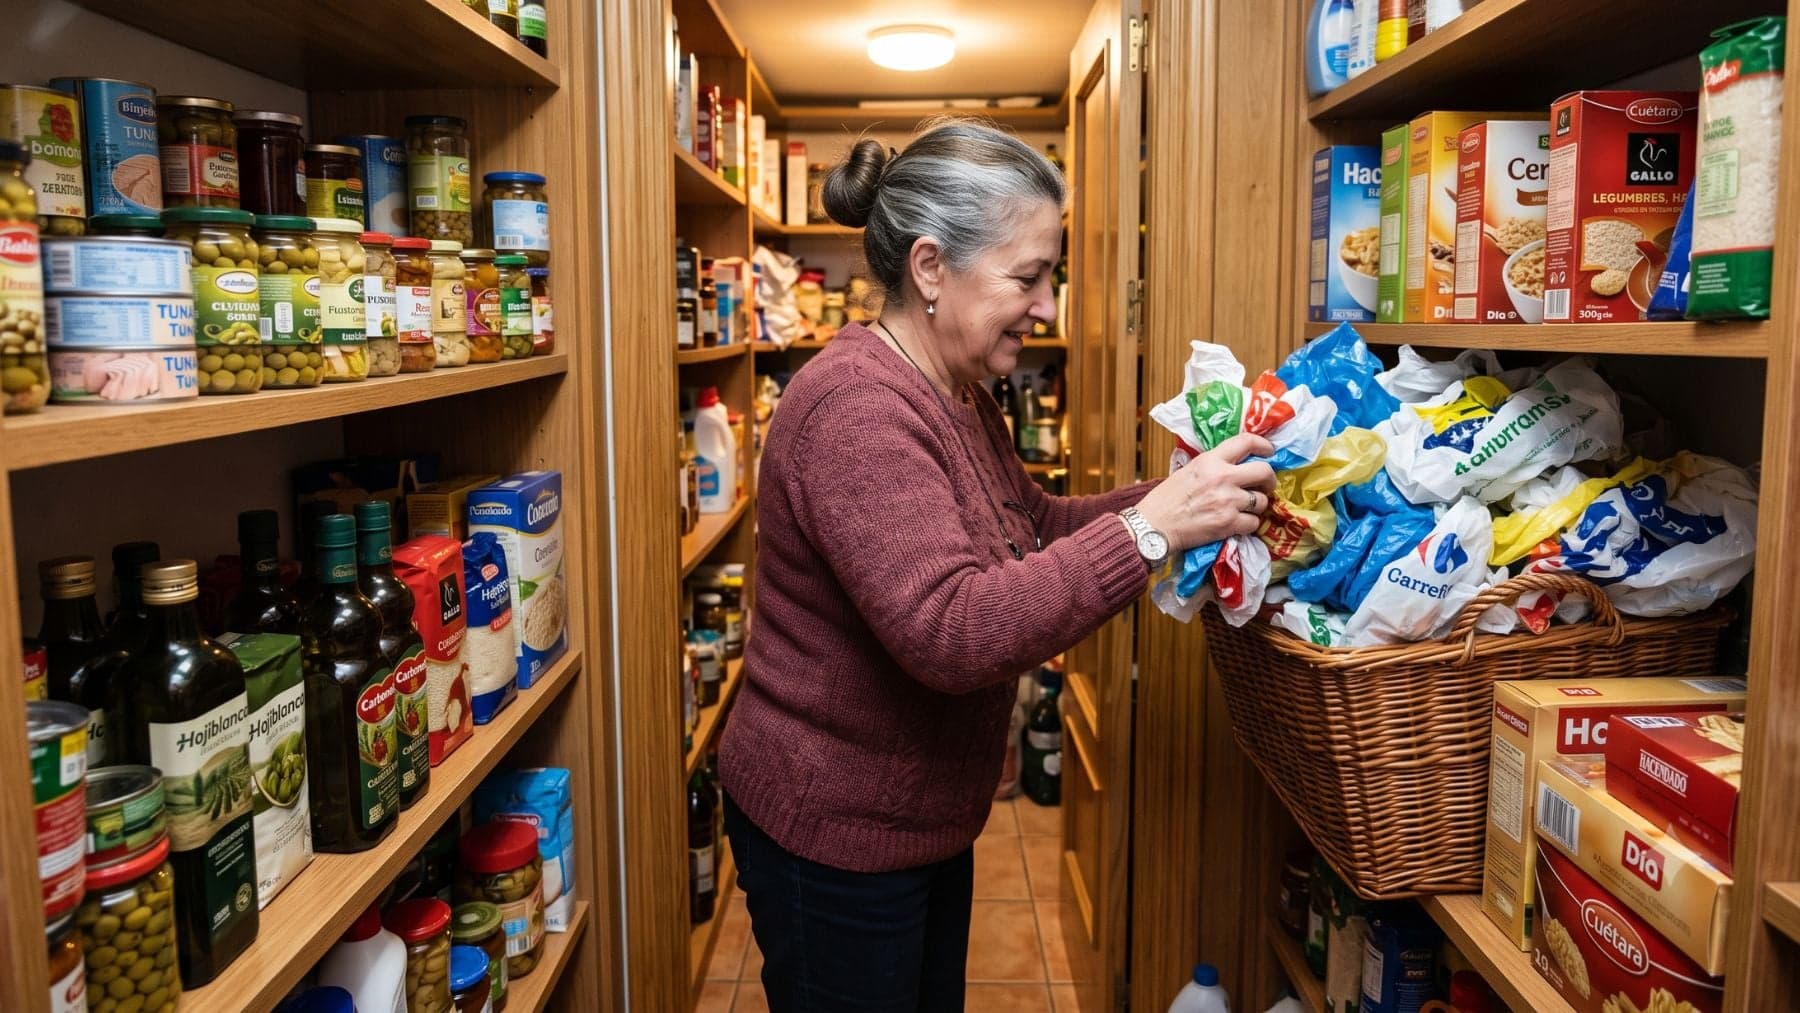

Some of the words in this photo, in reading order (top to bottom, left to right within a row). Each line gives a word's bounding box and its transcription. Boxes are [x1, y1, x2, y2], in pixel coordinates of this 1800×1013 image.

[1628, 105, 1679, 118] Cuétara
[1343, 162, 1382, 185] Hac
[1507, 157, 1550, 180] Cer
[1630, 170, 1674, 182] GALLO
[1593, 192, 1669, 205] LEGUMBRES,
[1638, 750, 1687, 794] HACENDADO
[1625, 839, 1660, 883] Día
[1584, 906, 1644, 968] Cuétara
